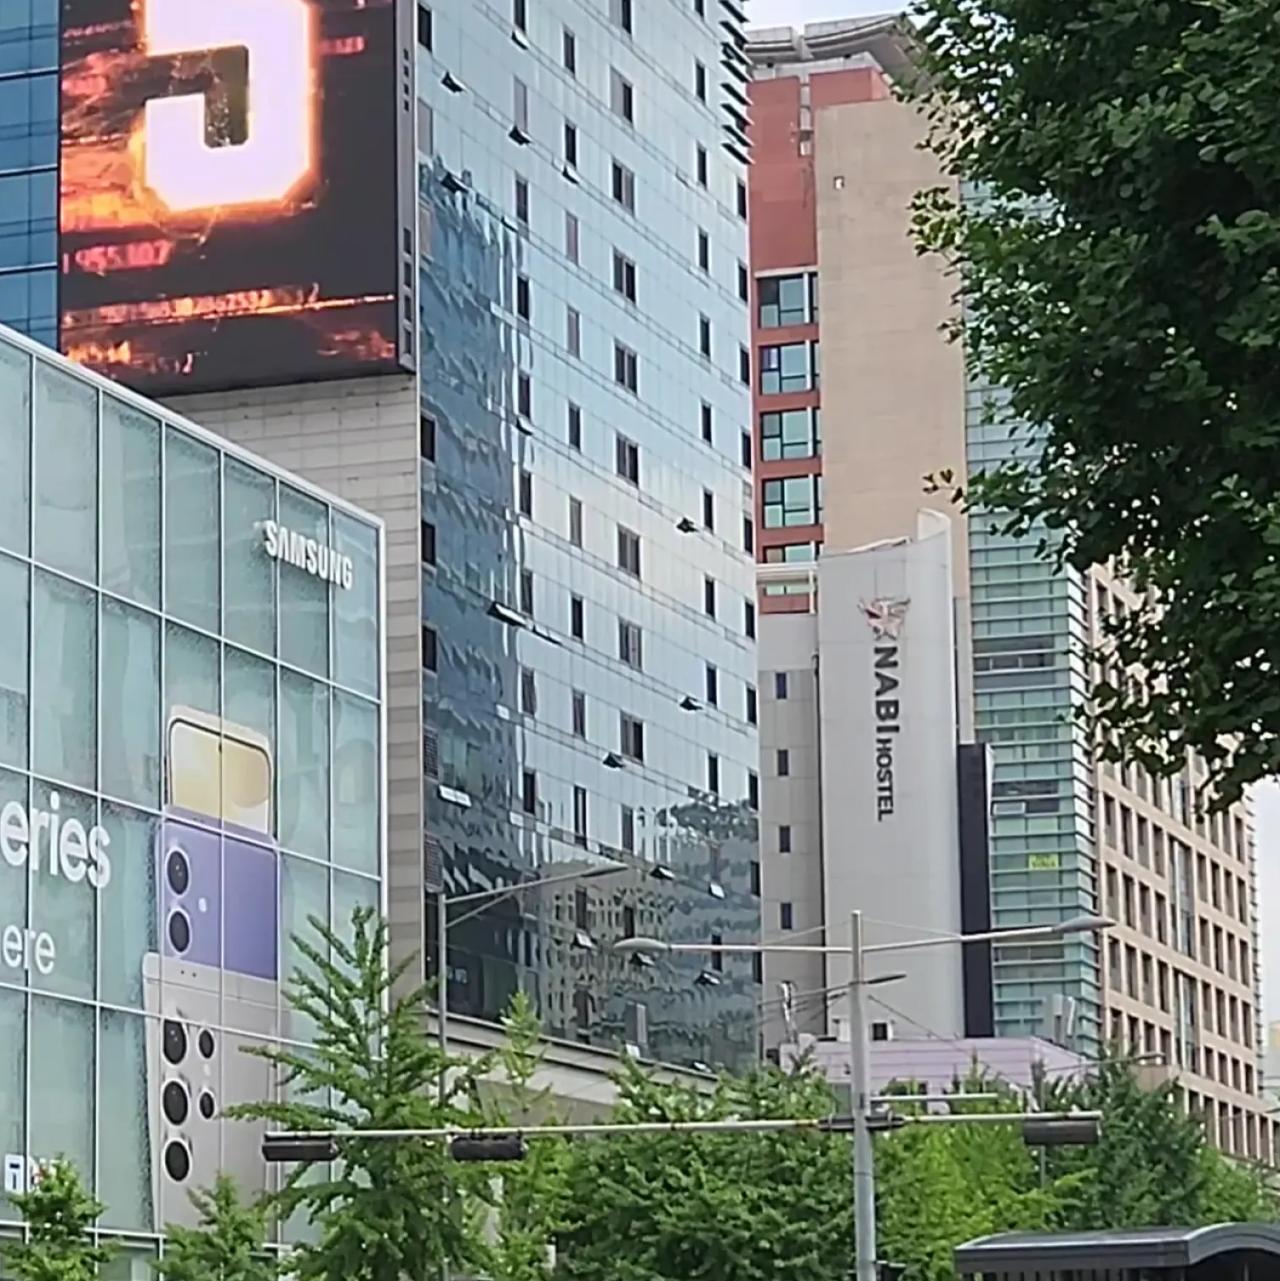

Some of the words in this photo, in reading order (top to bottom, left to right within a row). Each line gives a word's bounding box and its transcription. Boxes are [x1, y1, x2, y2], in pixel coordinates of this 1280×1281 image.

[263, 519, 353, 590] SAMSUNG
[873, 645, 900, 734] NABI
[875, 737, 895, 822] HOSTEL
